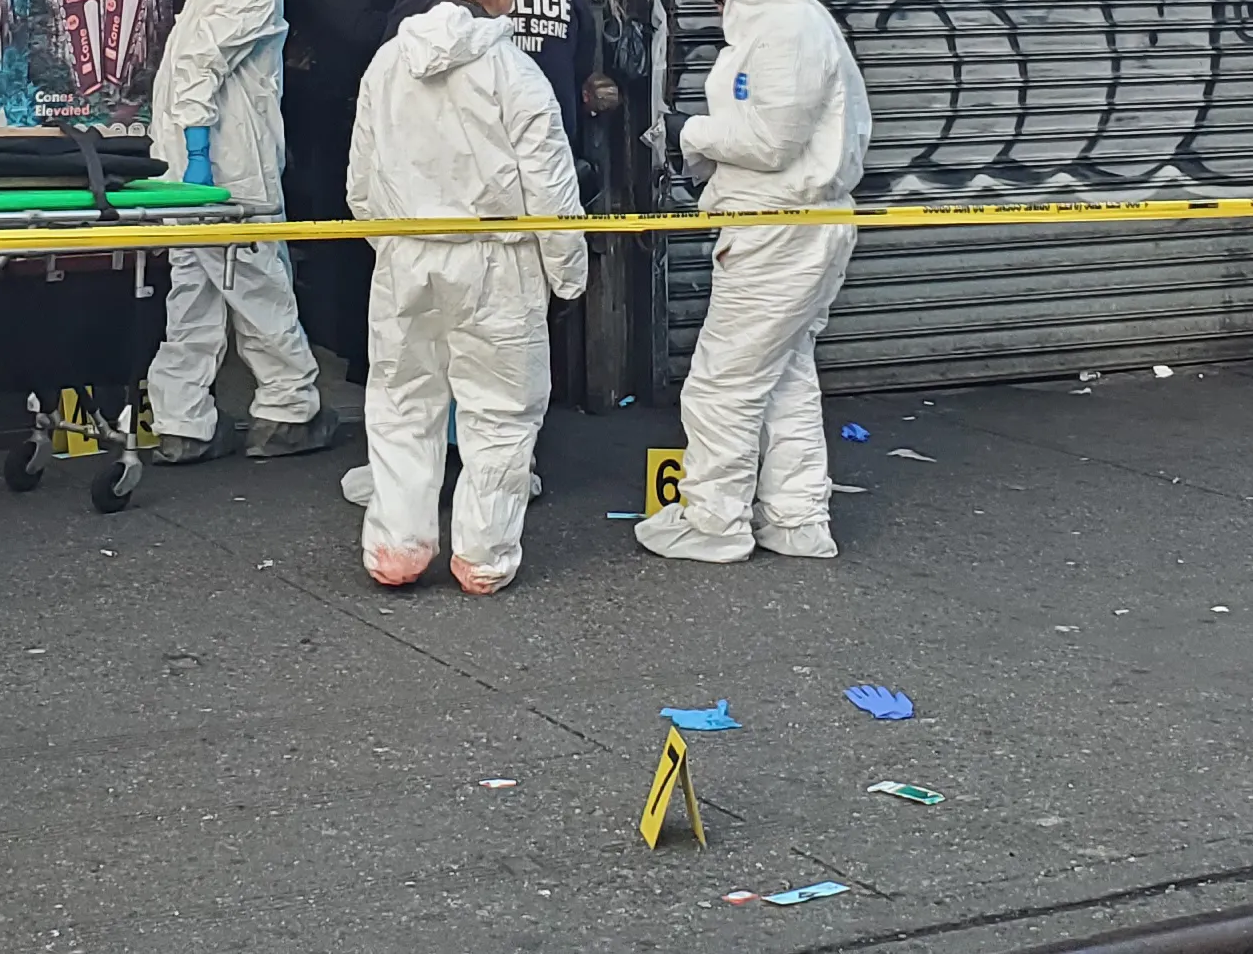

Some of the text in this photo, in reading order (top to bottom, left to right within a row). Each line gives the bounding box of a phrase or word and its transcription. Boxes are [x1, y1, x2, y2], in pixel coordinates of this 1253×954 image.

[108, 15, 121, 48] Cone
[530, 18, 568, 39] SCENE
[80, 29, 90, 62] Cone
[35, 91, 74, 103] Cones
[35, 104, 90, 117] Elevated
[655, 459, 683, 507] 6
[650, 743, 680, 815] 7
